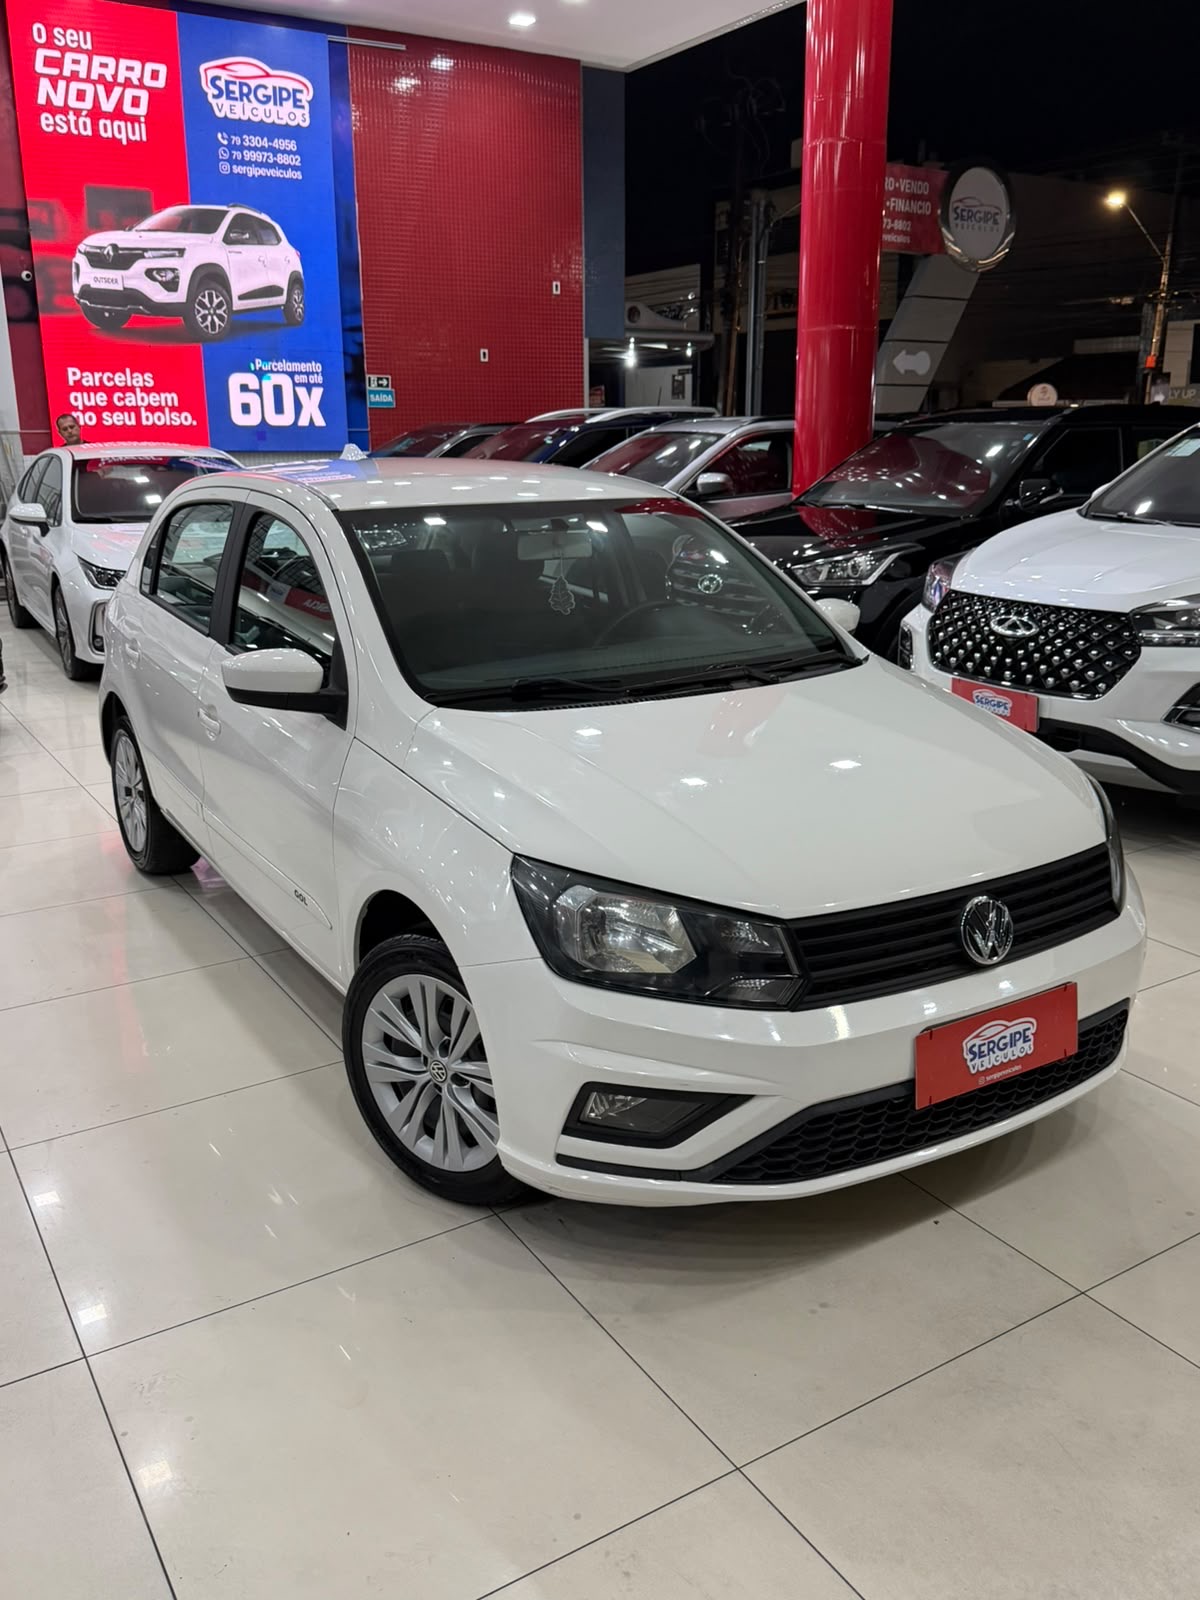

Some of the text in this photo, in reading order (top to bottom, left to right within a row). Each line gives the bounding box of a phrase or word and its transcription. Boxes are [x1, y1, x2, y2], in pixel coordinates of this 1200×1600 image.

[32, 22, 93, 50] O seu
[34, 47, 167, 89] CARRO
[37, 77, 149, 116] NOVO
[210, 75, 306, 110] SERGIPE
[216, 101, 307, 123] VEÍCULOS
[40, 110, 148, 146] está aqui
[230, 134, 297, 152] 79 3304-4956
[231, 149, 302, 167] 79 99973-8802
[231, 163, 303, 180] sergipeveiculos
[890, 197, 932, 215] FINANCIO
[953, 206, 999, 225] SERGIPE
[255, 358, 323, 373] Parcelamento
[66, 367, 155, 388] Parcelas
[294, 372, 324, 384] em até
[69, 387, 179, 411] que cabem
[228, 372, 327, 427] 60x
[369, 393, 394, 403] SAÍDA
[71, 406, 198, 427] no seu bolso.
[975, 694, 1009, 711] SERGIPE
[294, 889, 308, 906] GOL
[968, 1027, 1032, 1062] SERGIPE
